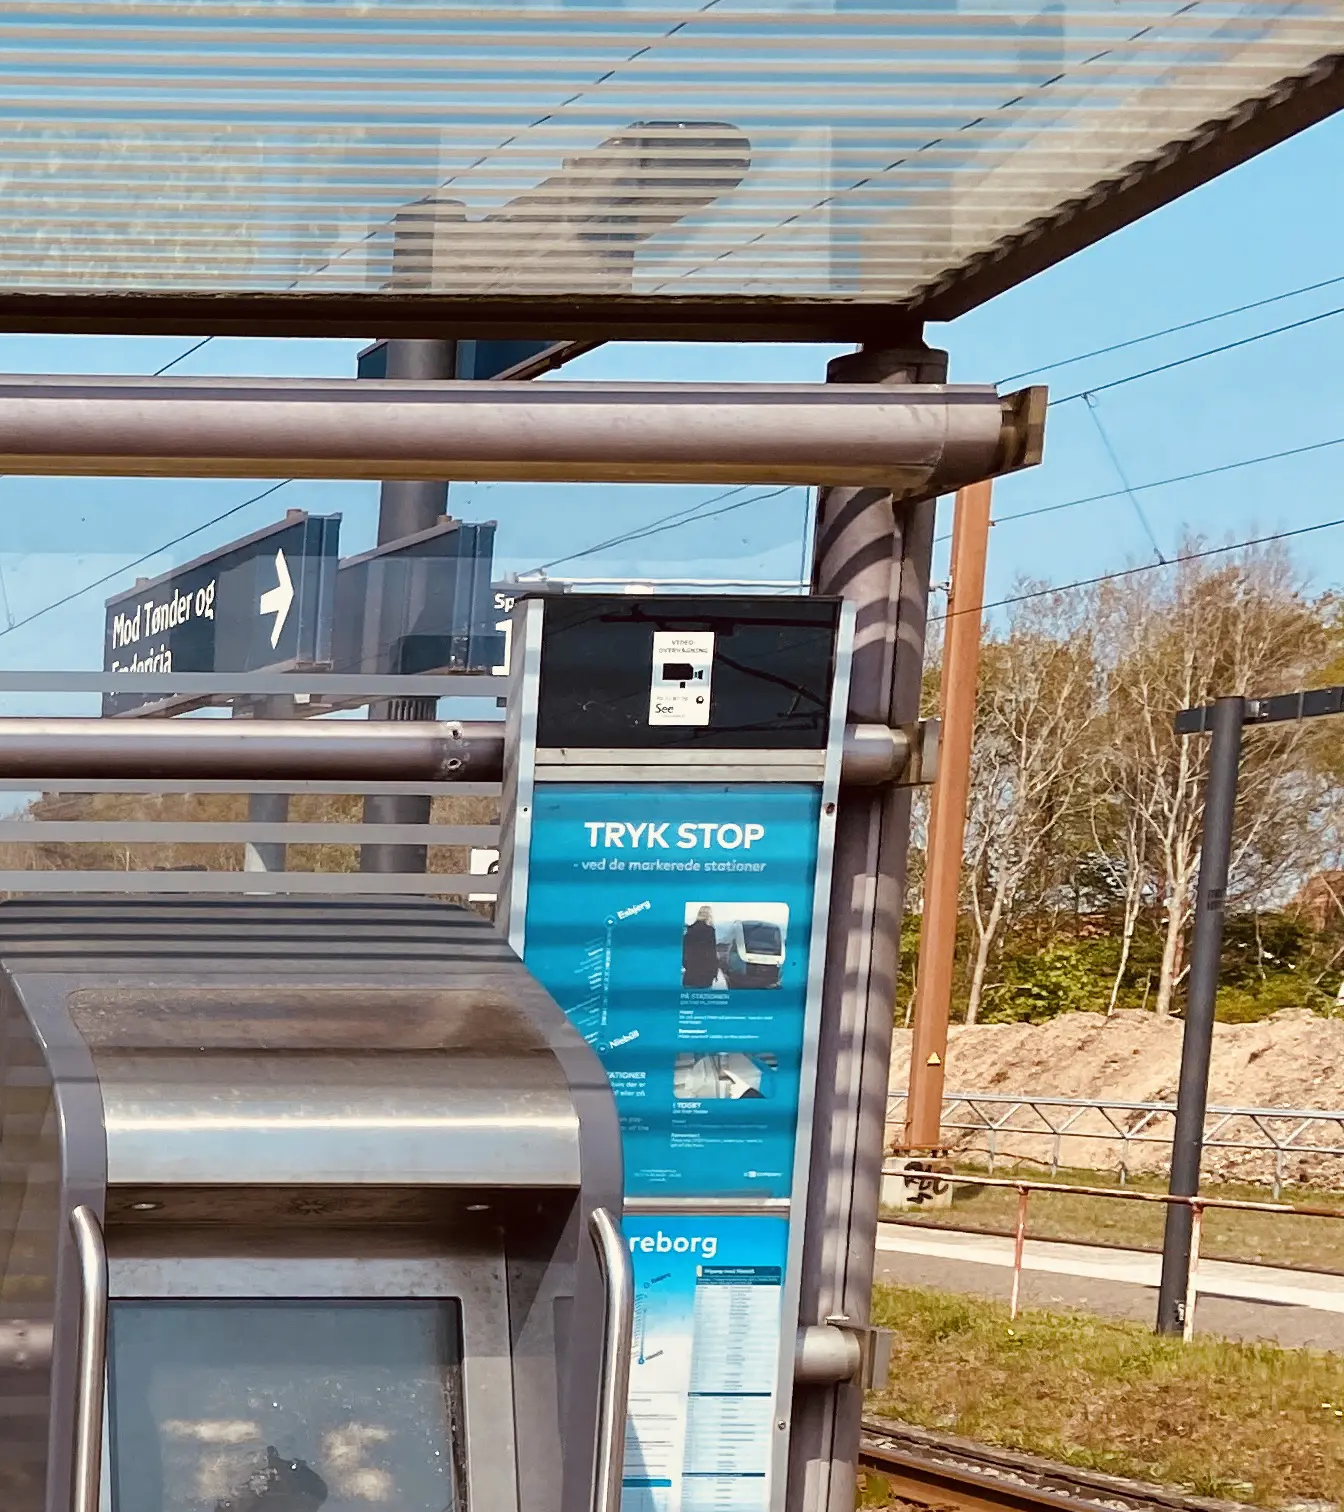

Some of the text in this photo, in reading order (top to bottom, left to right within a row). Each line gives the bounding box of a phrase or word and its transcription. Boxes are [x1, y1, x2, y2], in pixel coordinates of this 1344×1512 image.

[112, 579, 216, 650] Mod Tønder og
[584, 821, 765, 850] TRYK STOP
[582, 858, 606, 871] ved
[609, 858, 624, 871] de
[628, 858, 701, 872] markerede
[704, 859, 767, 873] stationer
[629, 1231, 718, 1259] reborg
